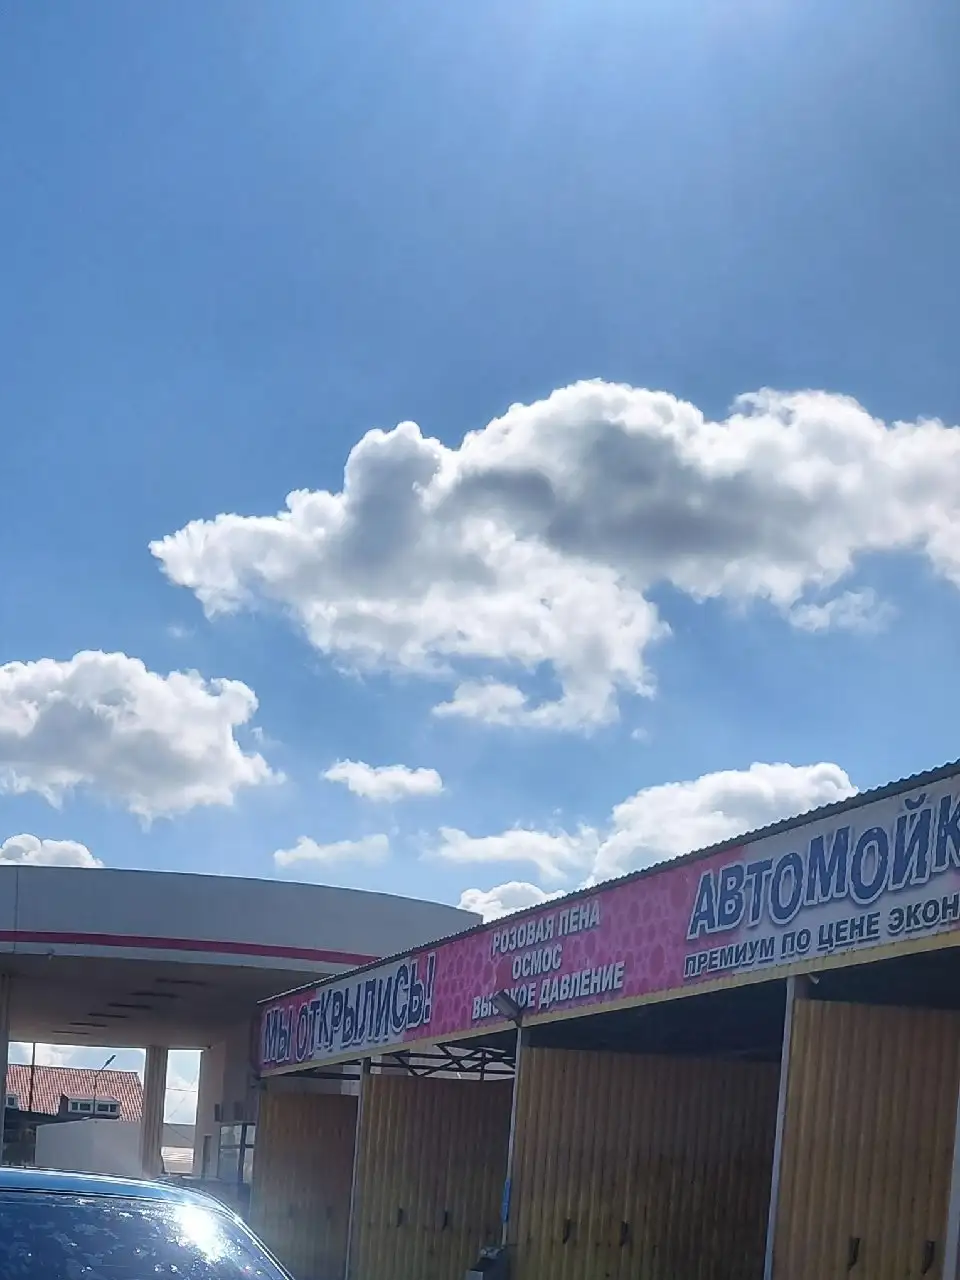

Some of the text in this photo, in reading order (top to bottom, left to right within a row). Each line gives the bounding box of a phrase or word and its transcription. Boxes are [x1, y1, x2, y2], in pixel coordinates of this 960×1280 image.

[687, 793, 960, 939] АВТОМОЙК
[492, 900, 600, 955] РОЗОВАЯ ПЕНА
[512, 944, 563, 980] ОСМОС
[683, 893, 960, 977] ПРЕМИУМ ПО ЦЕНЕ ЭКОН
[263, 952, 437, 1063] МЫ ОТКРЫЛИСЬ!
[471, 961, 625, 1020] ВЫКОЕ ДАВЛЕНИЕ
